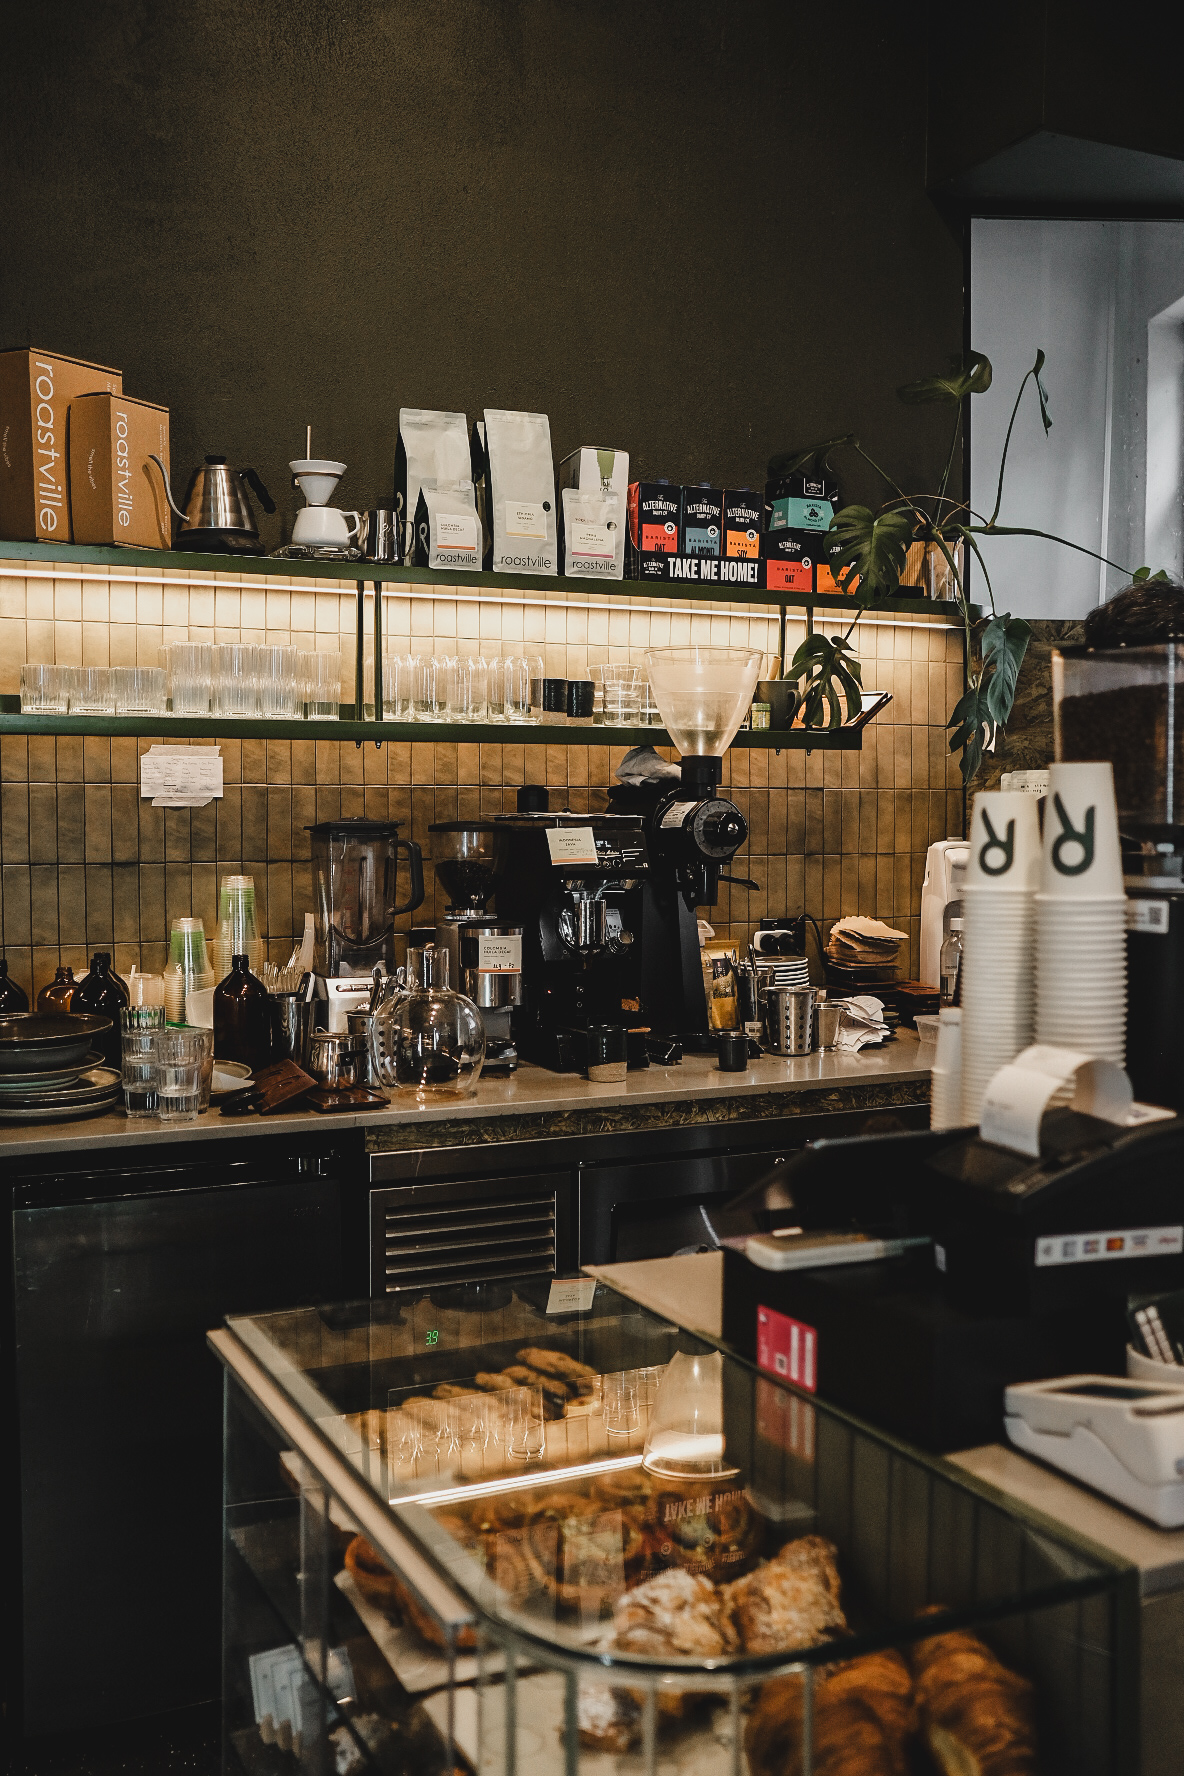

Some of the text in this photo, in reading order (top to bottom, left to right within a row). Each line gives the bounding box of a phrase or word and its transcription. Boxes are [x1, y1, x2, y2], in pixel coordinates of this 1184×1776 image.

[35, 361, 63, 532] roastville
[116, 411, 133, 527] roastville
[642, 500, 678, 513] ALTERNATIVE
[687, 504, 721, 517] ALTERNATIVE
[727, 508, 760, 521] ALTERNATIVE
[654, 543, 666, 552] OAT
[736, 549, 748, 558] SOY
[436, 553, 477, 564] roastville
[500, 555, 552, 568] roastville
[572, 560, 616, 571] roastville
[667, 557, 759, 583] TAKE ME HOME!
[784, 574, 795, 583] OAT
